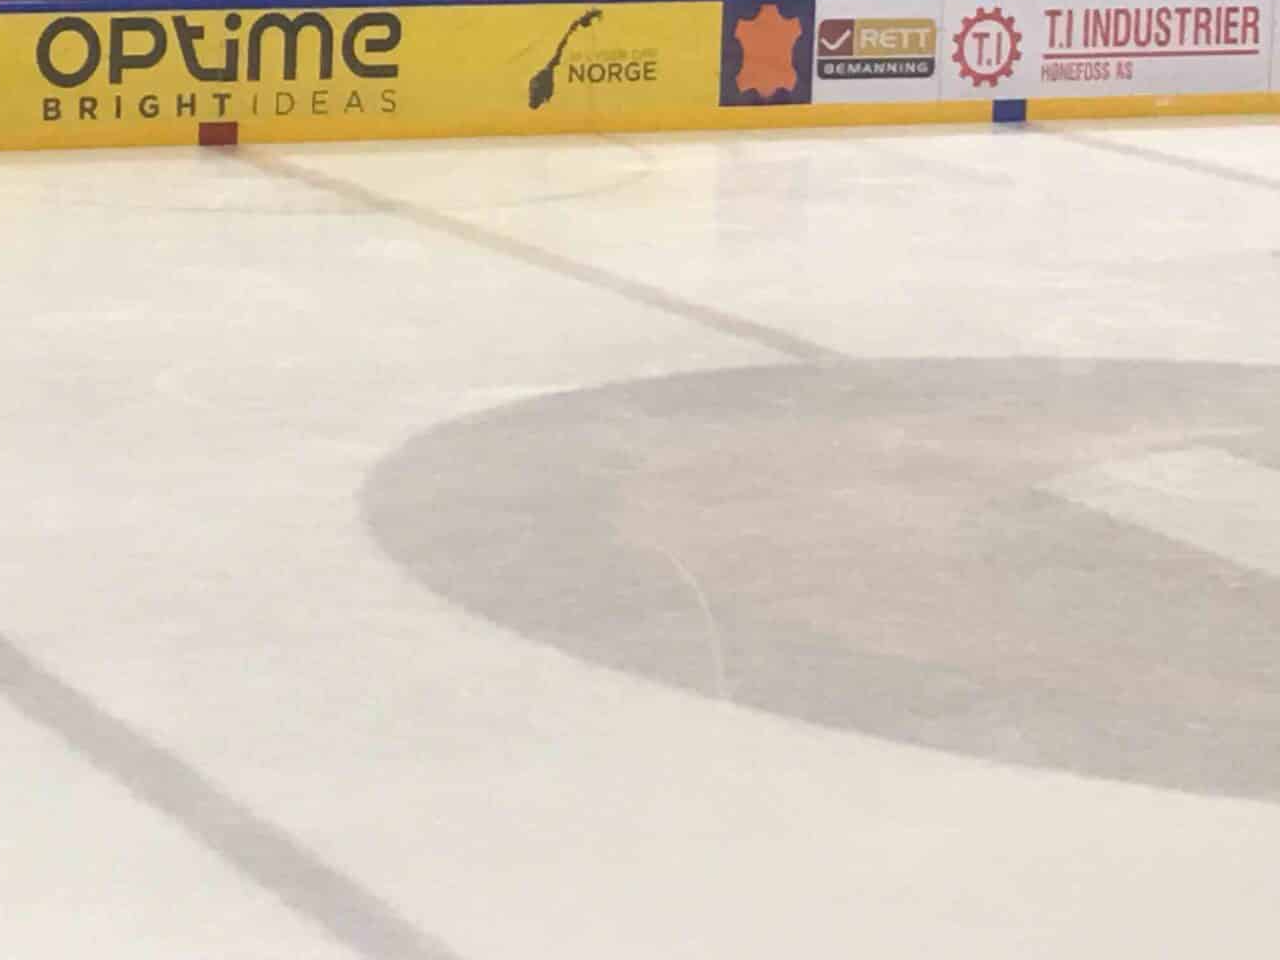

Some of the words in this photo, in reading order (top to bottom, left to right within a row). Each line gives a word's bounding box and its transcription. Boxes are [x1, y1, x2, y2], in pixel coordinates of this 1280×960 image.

[859, 28, 931, 49] RETT
[1044, 9, 1073, 49] T.I
[1083, 6, 1260, 48] INDUSTRIER
[972, 31, 1003, 67] T.I
[568, 61, 657, 83] NORGE
[823, 61, 929, 75] BEMANNING
[1041, 62, 1110, 82] HØNEFOSS
[1116, 61, 1133, 80] AS
[42, 93, 232, 121] BRIGHT
[252, 89, 397, 116] IDEAS
